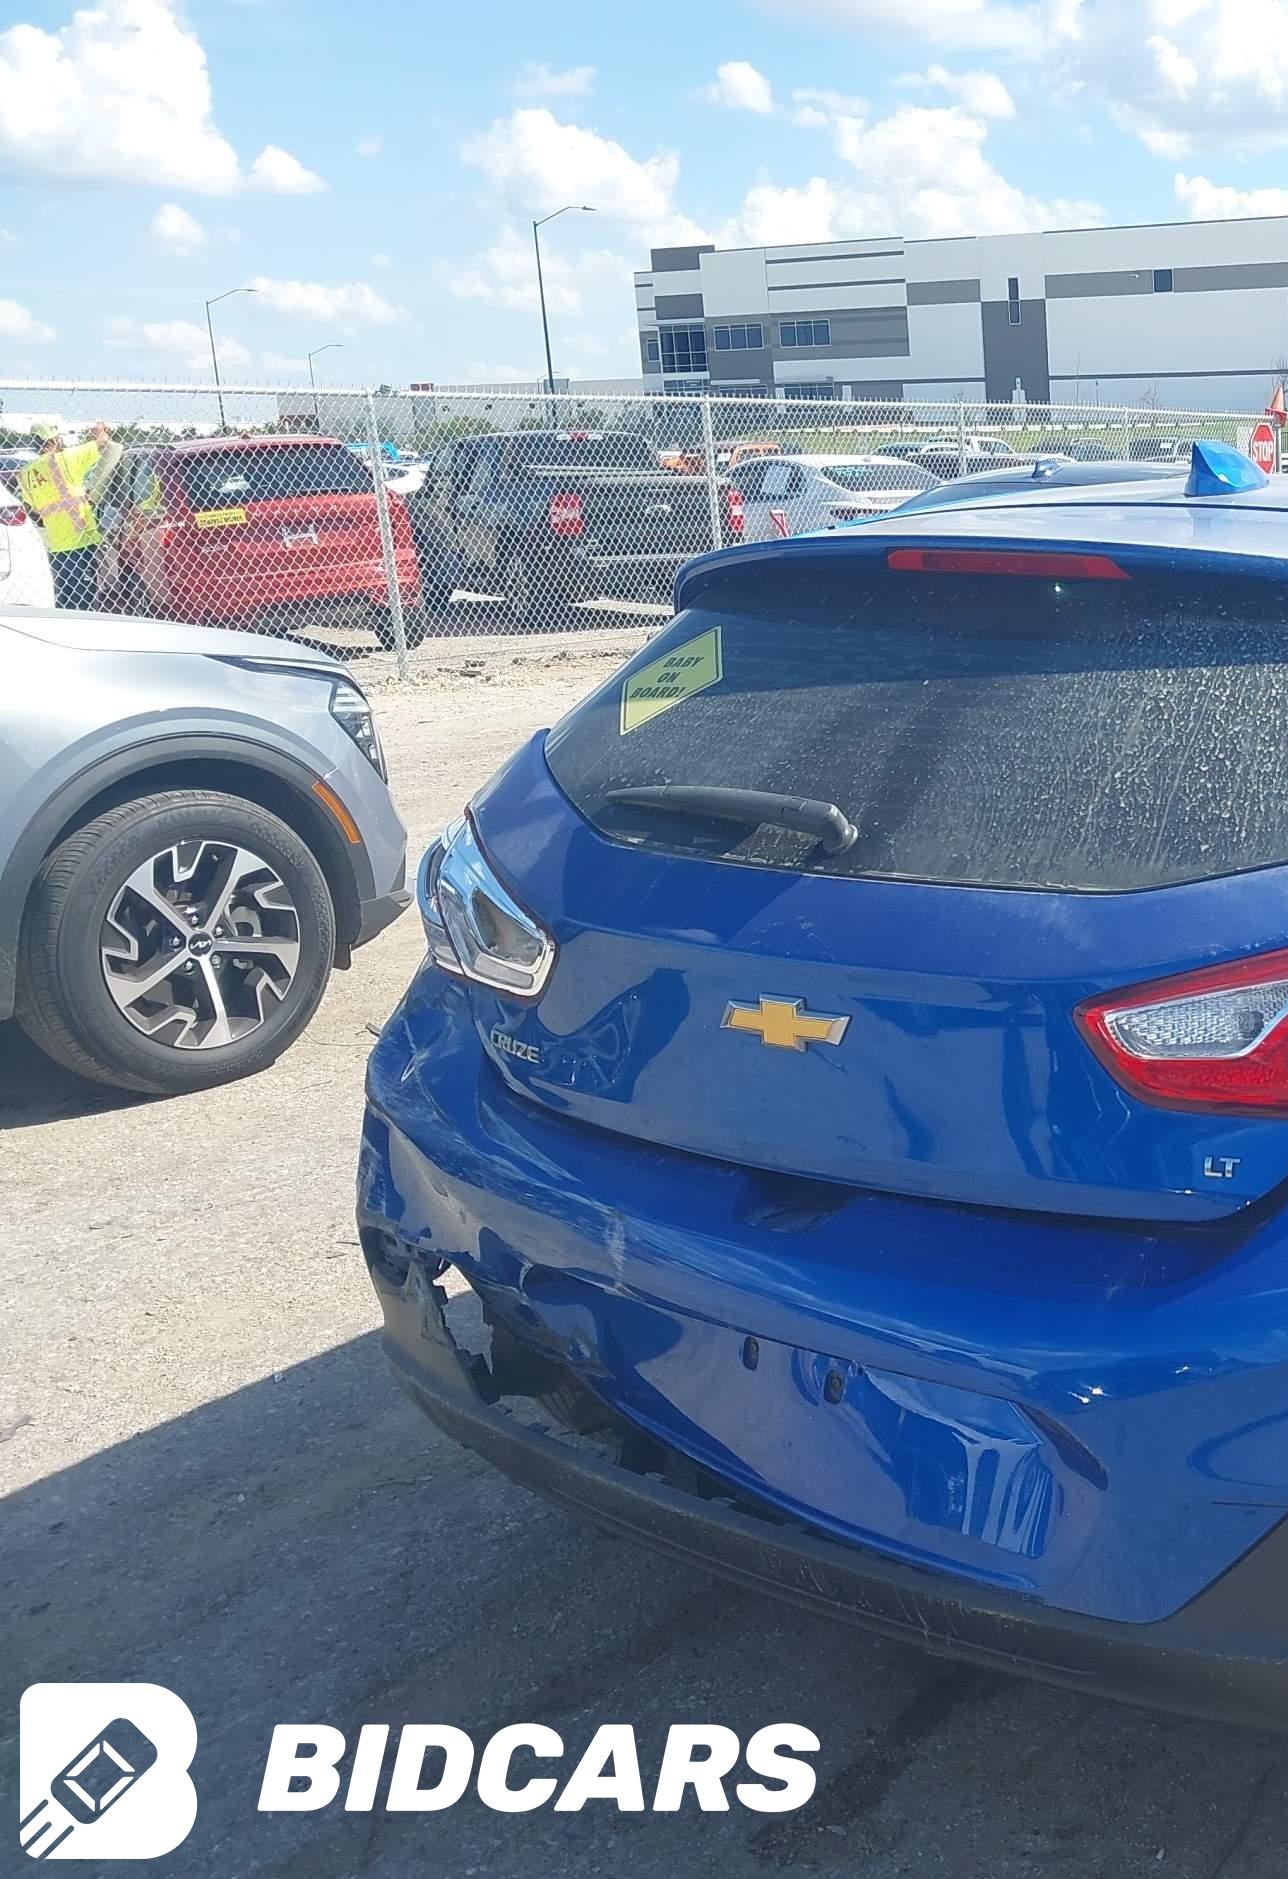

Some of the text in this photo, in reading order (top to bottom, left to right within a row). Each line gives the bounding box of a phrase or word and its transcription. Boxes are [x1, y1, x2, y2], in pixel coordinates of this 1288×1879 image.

[1253, 440, 1274, 462] STOP
[663, 656, 704, 668] BABY
[656, 671, 681, 683] ON
[630, 686, 687, 698] BOARD!
[490, 1028, 540, 1064] CRUZE
[1204, 1156, 1240, 1178] LT
